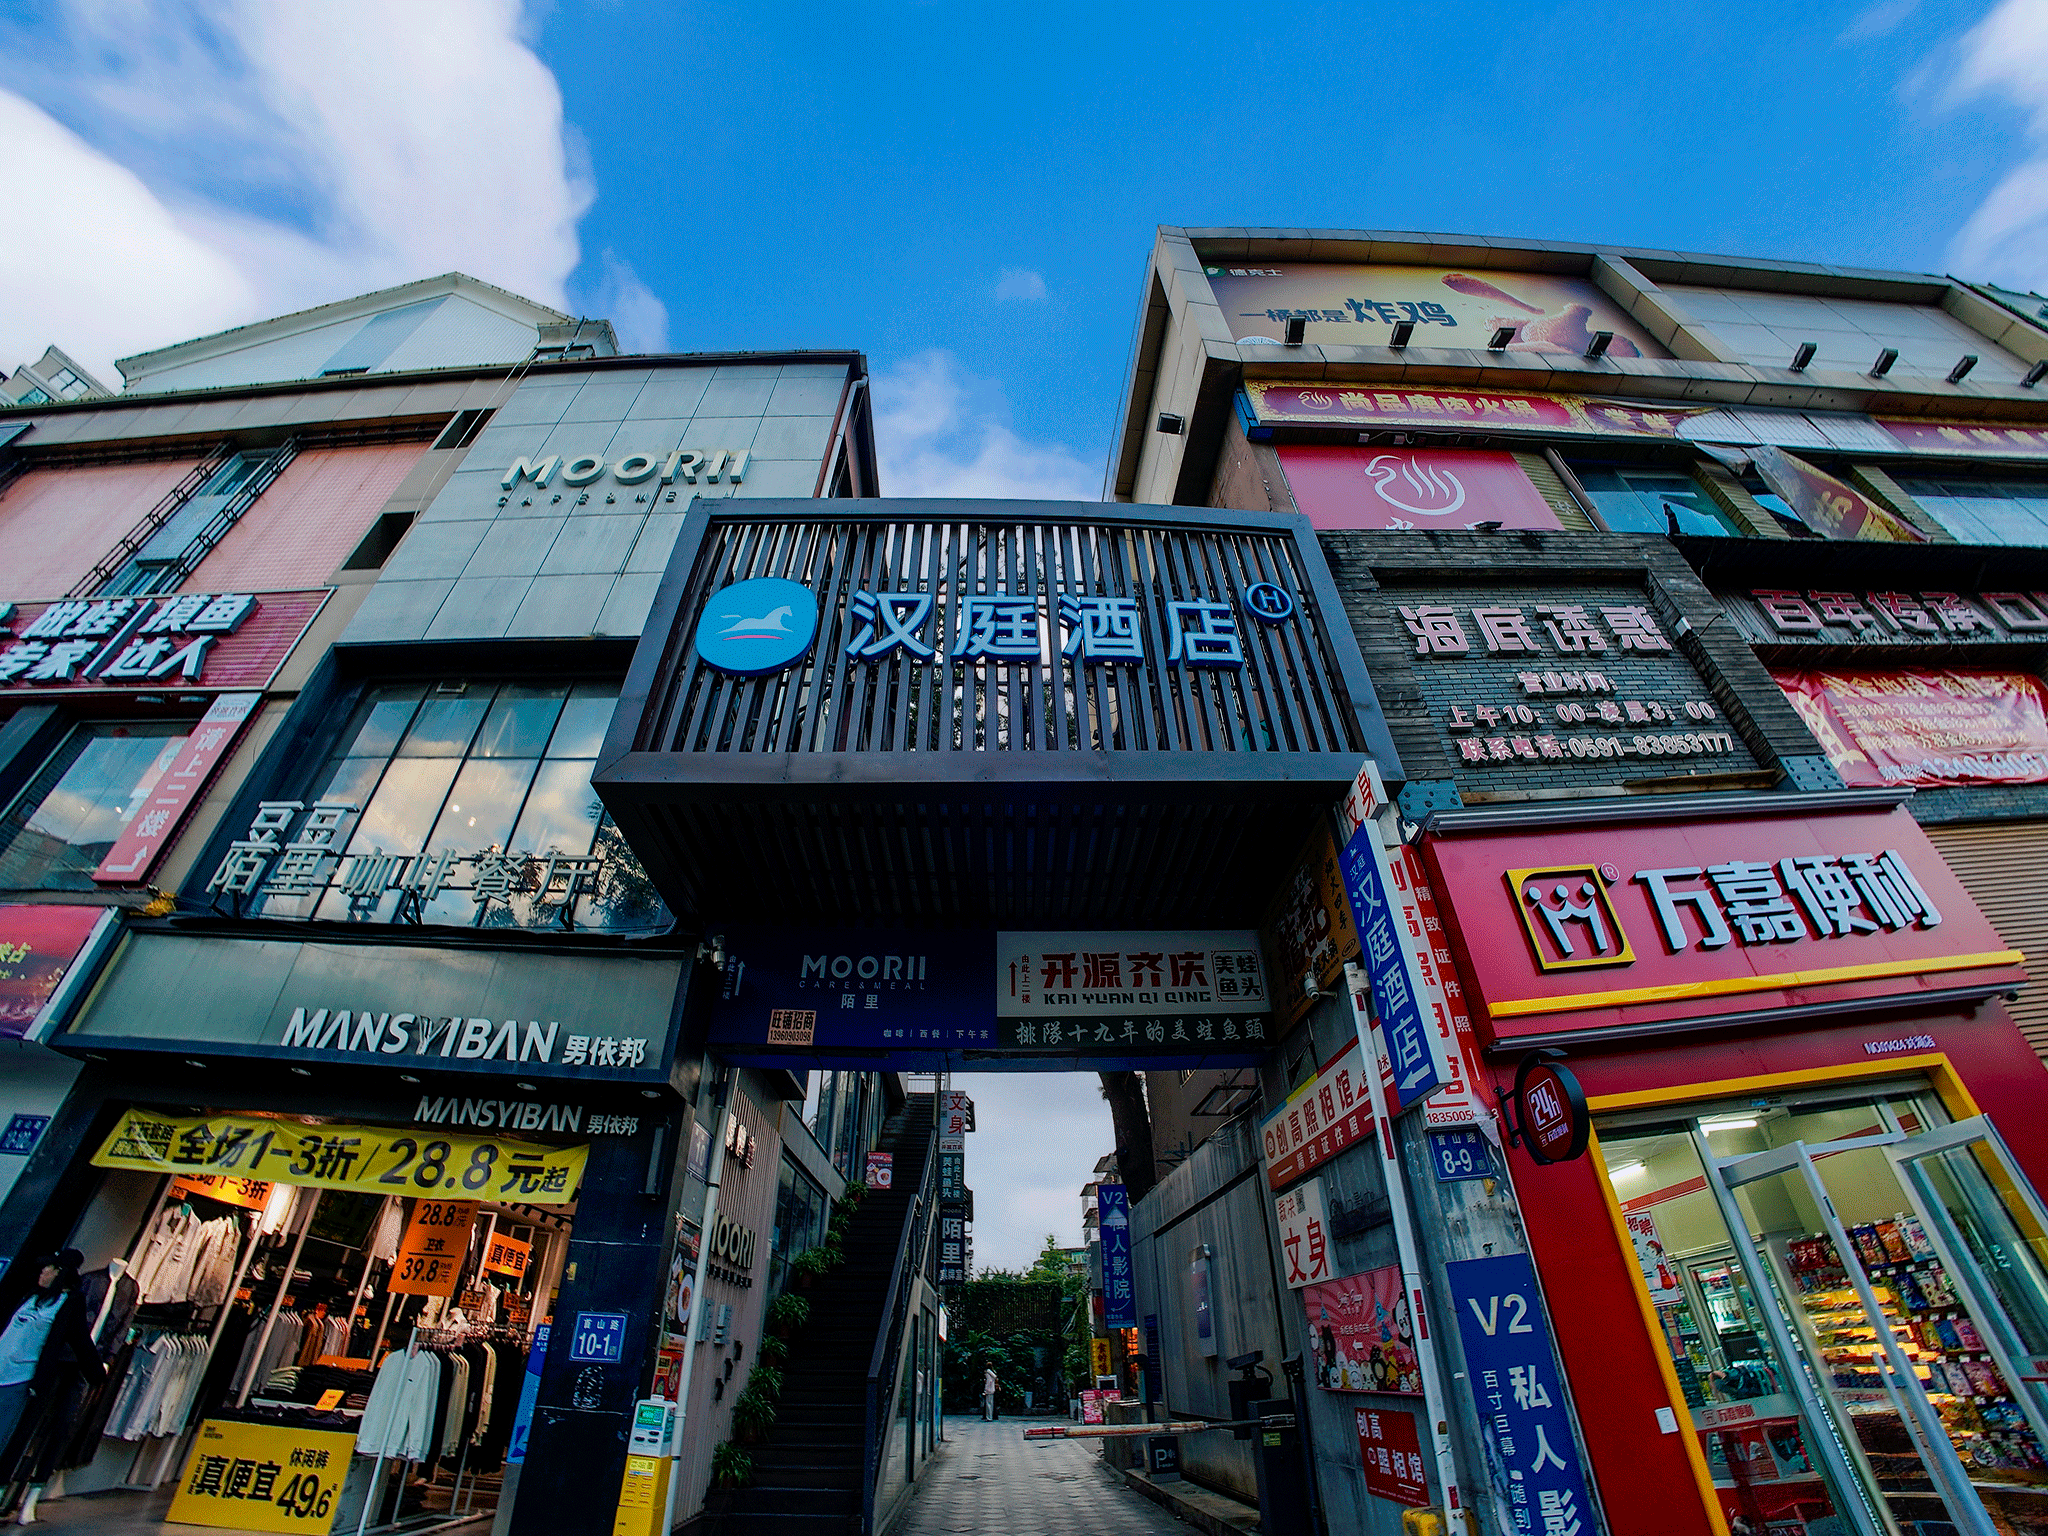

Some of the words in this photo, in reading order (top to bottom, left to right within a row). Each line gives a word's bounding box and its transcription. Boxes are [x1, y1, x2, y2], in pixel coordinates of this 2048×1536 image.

[500, 448, 755, 491] MOORII
[846, 589, 1246, 668] 汉庭酒店
[1398, 605, 1672, 658] 海底诱惑
[1750, 590, 2048, 633] 百年传承口
[206, 846, 603, 906] 陌里咖啡餐厅
[1636, 850, 1942, 952] 万嘉便利
[801, 954, 926, 980] MOORII
[1020, 954, 1031, 1004] 由此上二楼
[1040, 951, 1209, 989] 开源齐庆
[1352, 871, 1423, 1074] 汉庭酒店
[1414, 885, 1472, 1034] 精致证件照
[841, 993, 879, 1009] 陌里
[280, 1007, 560, 1063] MANSYIBAN
[560, 1035, 649, 1067] 男依邦
[413, 1096, 582, 1133] MANSYIBAN
[586, 1114, 639, 1136] 男依邦
[948, 1093, 964, 1135] 文身
[1275, 1068, 1355, 1153] 创高照相馆
[1426, 1110, 1474, 1124] 1835005
[1530, 1086, 1561, 1127] 24h
[419, 1203, 457, 1227] 28.8
[1102, 1191, 1124, 1205] V2
[940, 1217, 962, 1264] 陌里
[1627, 1216, 1653, 1237] 招聘
[401, 1257, 440, 1282] 39.8
[1284, 1216, 1329, 1284] 文身
[1469, 1293, 1533, 1337] V2
[195, 1454, 282, 1502] 真便宜
[276, 1473, 333, 1518] 49.6
[1376, 1446, 1424, 1484] 照相馆
